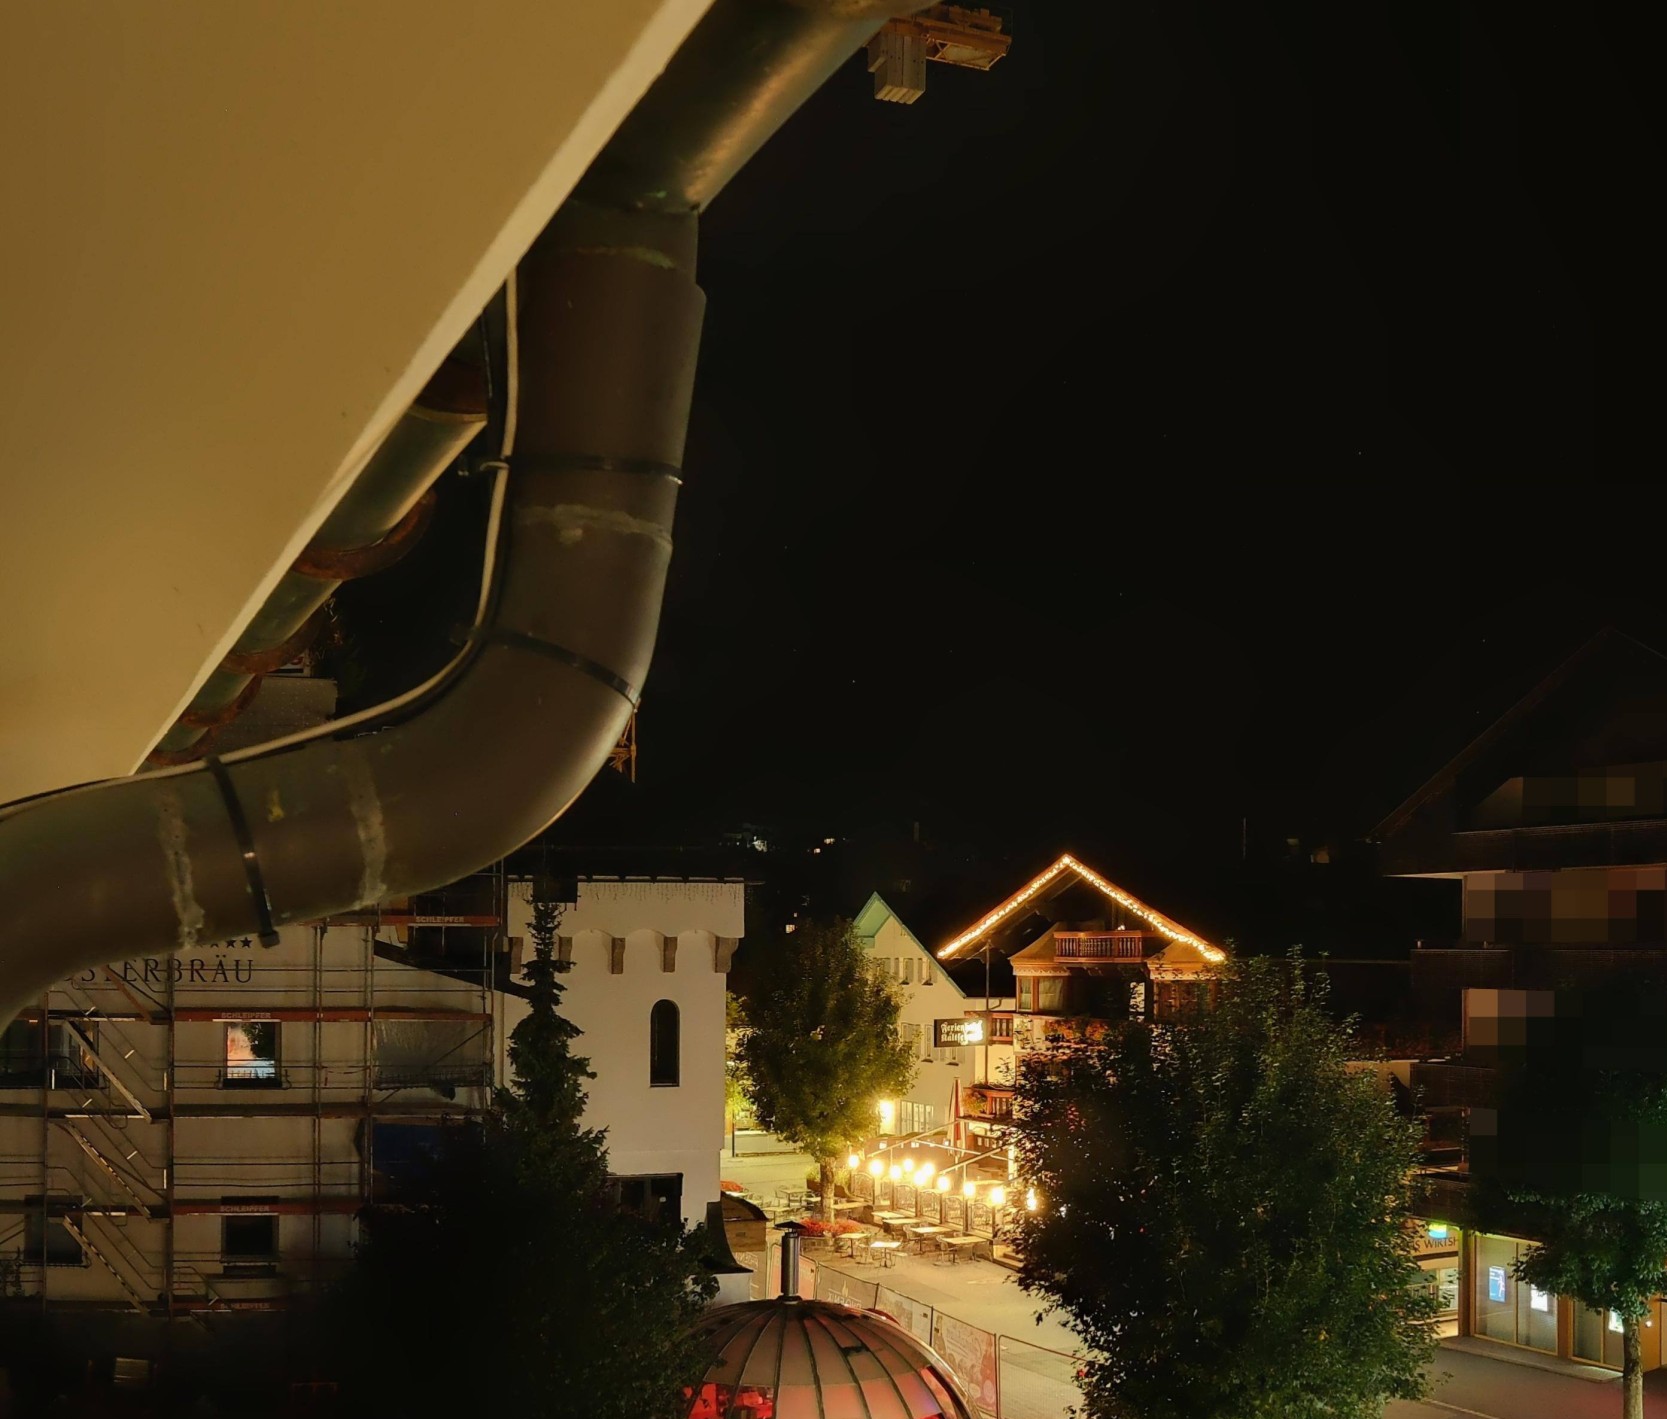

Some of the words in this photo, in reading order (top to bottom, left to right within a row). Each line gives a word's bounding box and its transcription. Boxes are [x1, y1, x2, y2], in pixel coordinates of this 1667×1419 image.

[415, 916, 465, 924] SCHLEIPFER
[221, 1012, 271, 1020] SCHLEIPFER
[219, 1205, 270, 1213] SCHLEIPFER
